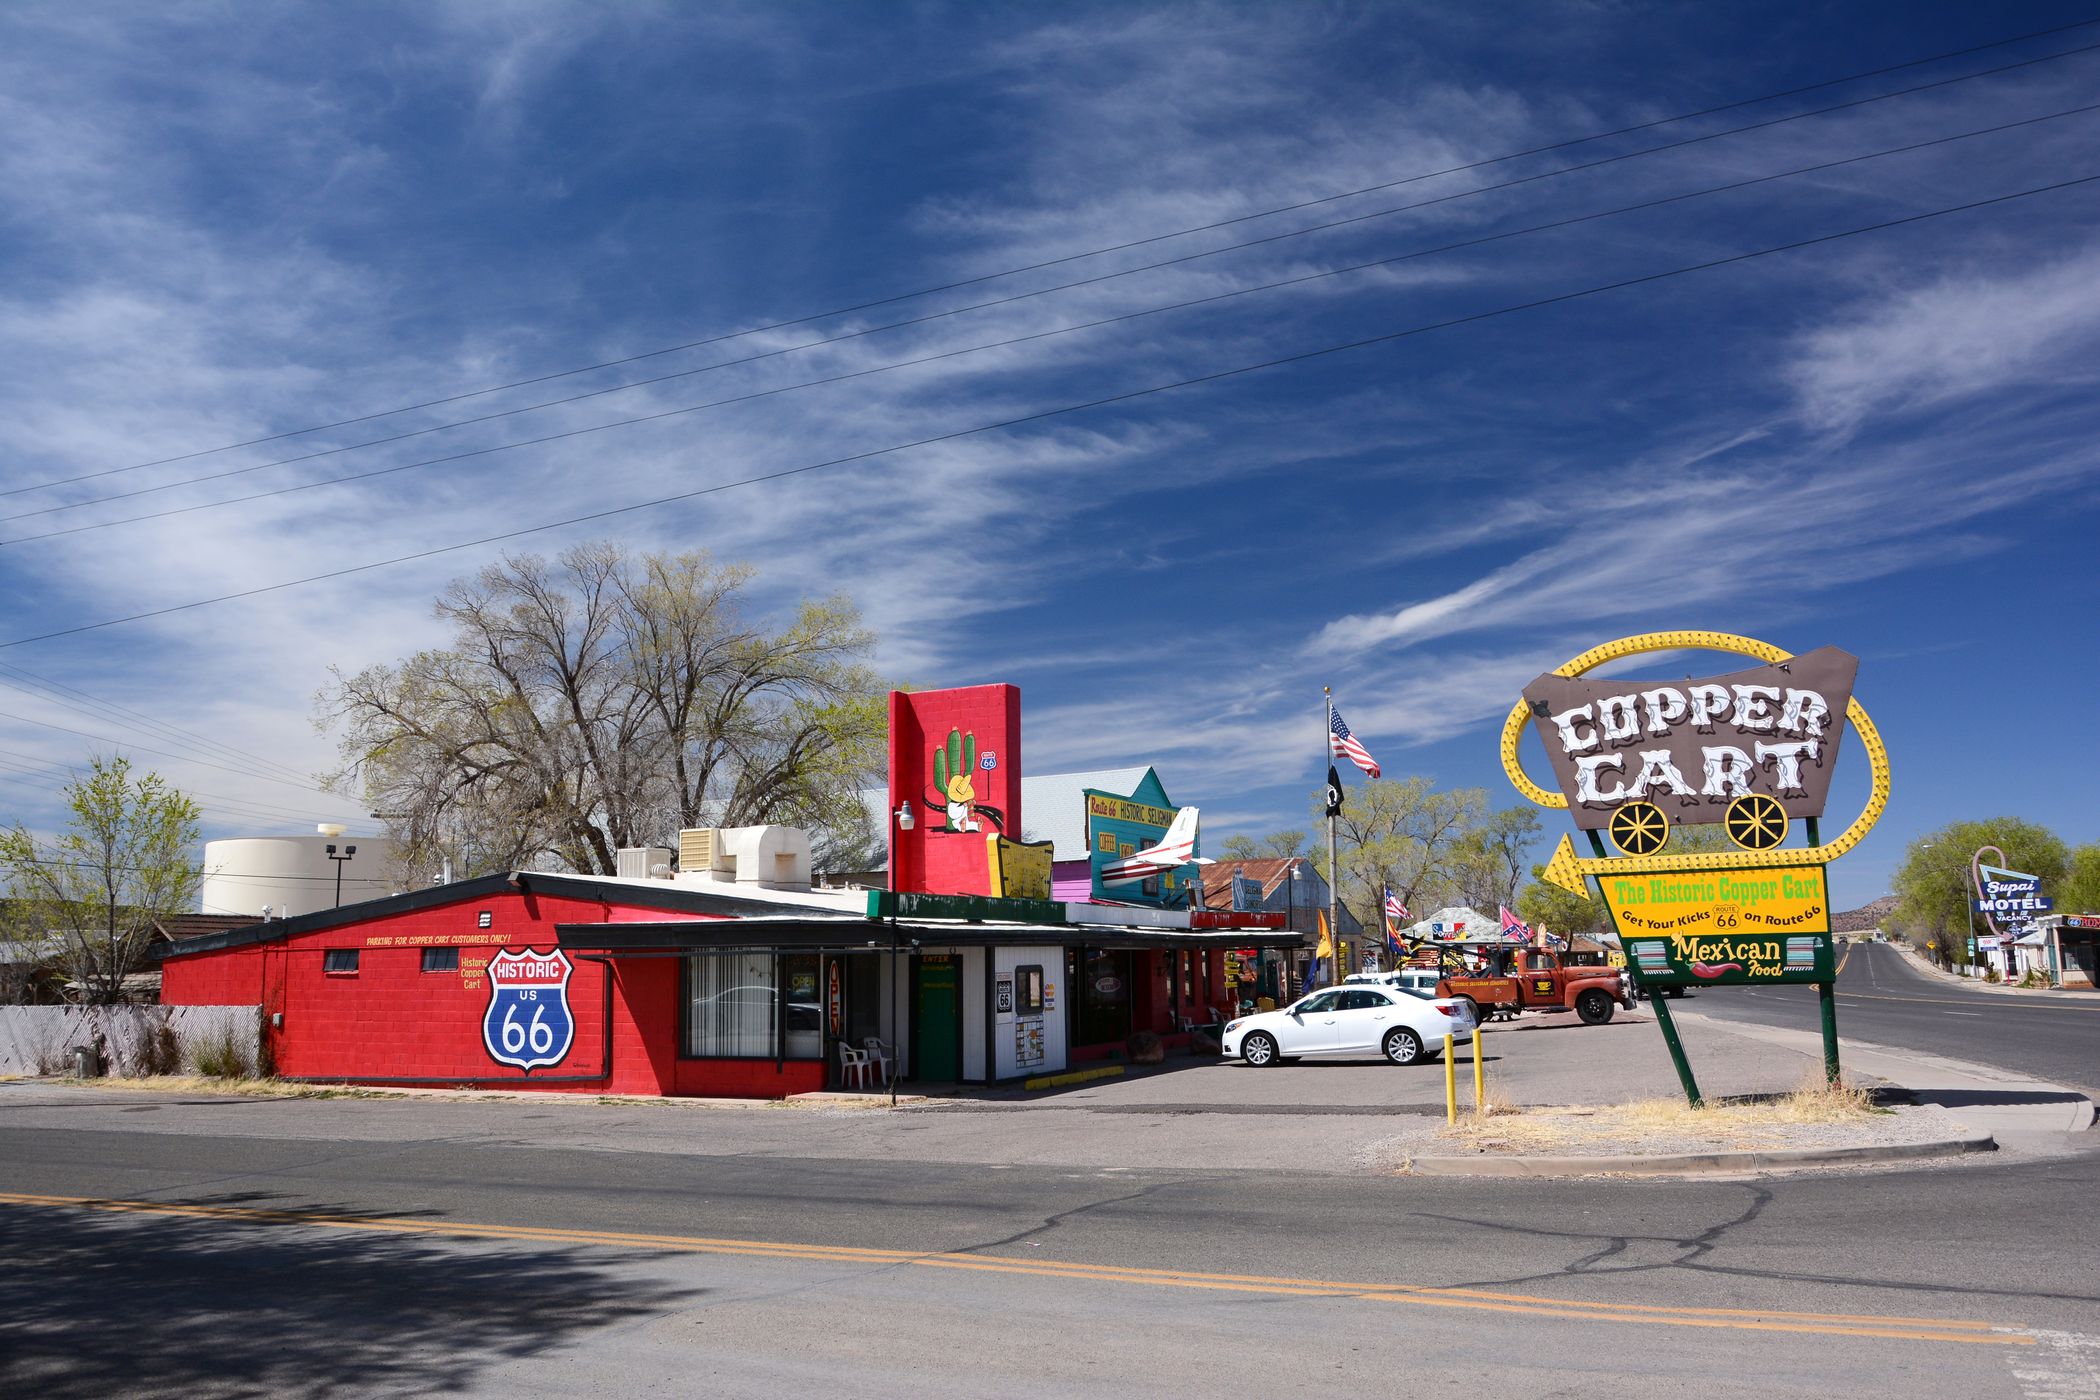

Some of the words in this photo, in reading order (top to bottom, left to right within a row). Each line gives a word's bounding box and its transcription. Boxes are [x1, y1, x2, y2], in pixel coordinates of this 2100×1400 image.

[1551, 684, 1830, 753] COPPER
[984, 758, 994, 767] 66
[1575, 738, 1819, 803] CART
[1091, 797, 1107, 816] Route
[1108, 801, 1117, 817] 66
[1120, 801, 1145, 822] HISTORIC
[1100, 834, 1115, 851] COFFEE
[1614, 881, 1646, 905] The
[1649, 878, 1715, 904] Historic
[1718, 877, 1778, 907] Copper
[1782, 874, 1820, 899] Cart
[1986, 880, 2035, 897] Supai
[1980, 898, 2047, 911] MOTEL
[1621, 910, 1643, 927] Get
[1647, 919, 1675, 930] Your
[1677, 911, 1711, 926] Kicks
[1716, 915, 1737, 928] 66
[1744, 912, 1761, 923] on
[1765, 914, 1804, 926] Route
[1804, 905, 1821, 919] 66
[366, 936, 392, 946] PARKING
[395, 936, 407, 945] FOR
[409, 935, 433, 945] COPPER
[434, 935, 450, 944] CART
[451, 934, 489, 944] CUSTOMERS
[490, 934, 511, 943] ONLY!
[1674, 937, 1781, 962] Mexican
[461, 957, 488, 968] Historic
[497, 962, 559, 978] HISTORIC
[1748, 959, 1783, 977] Food
[460, 968, 486, 979] Copper
[792, 976, 816, 987] OPEN
[463, 978, 481, 989] Cart
[519, 990, 537, 1001] US
[830, 963, 839, 1035] OPEN
[1000, 994, 1009, 1007] 66
[502, 1003, 553, 1054] 66
